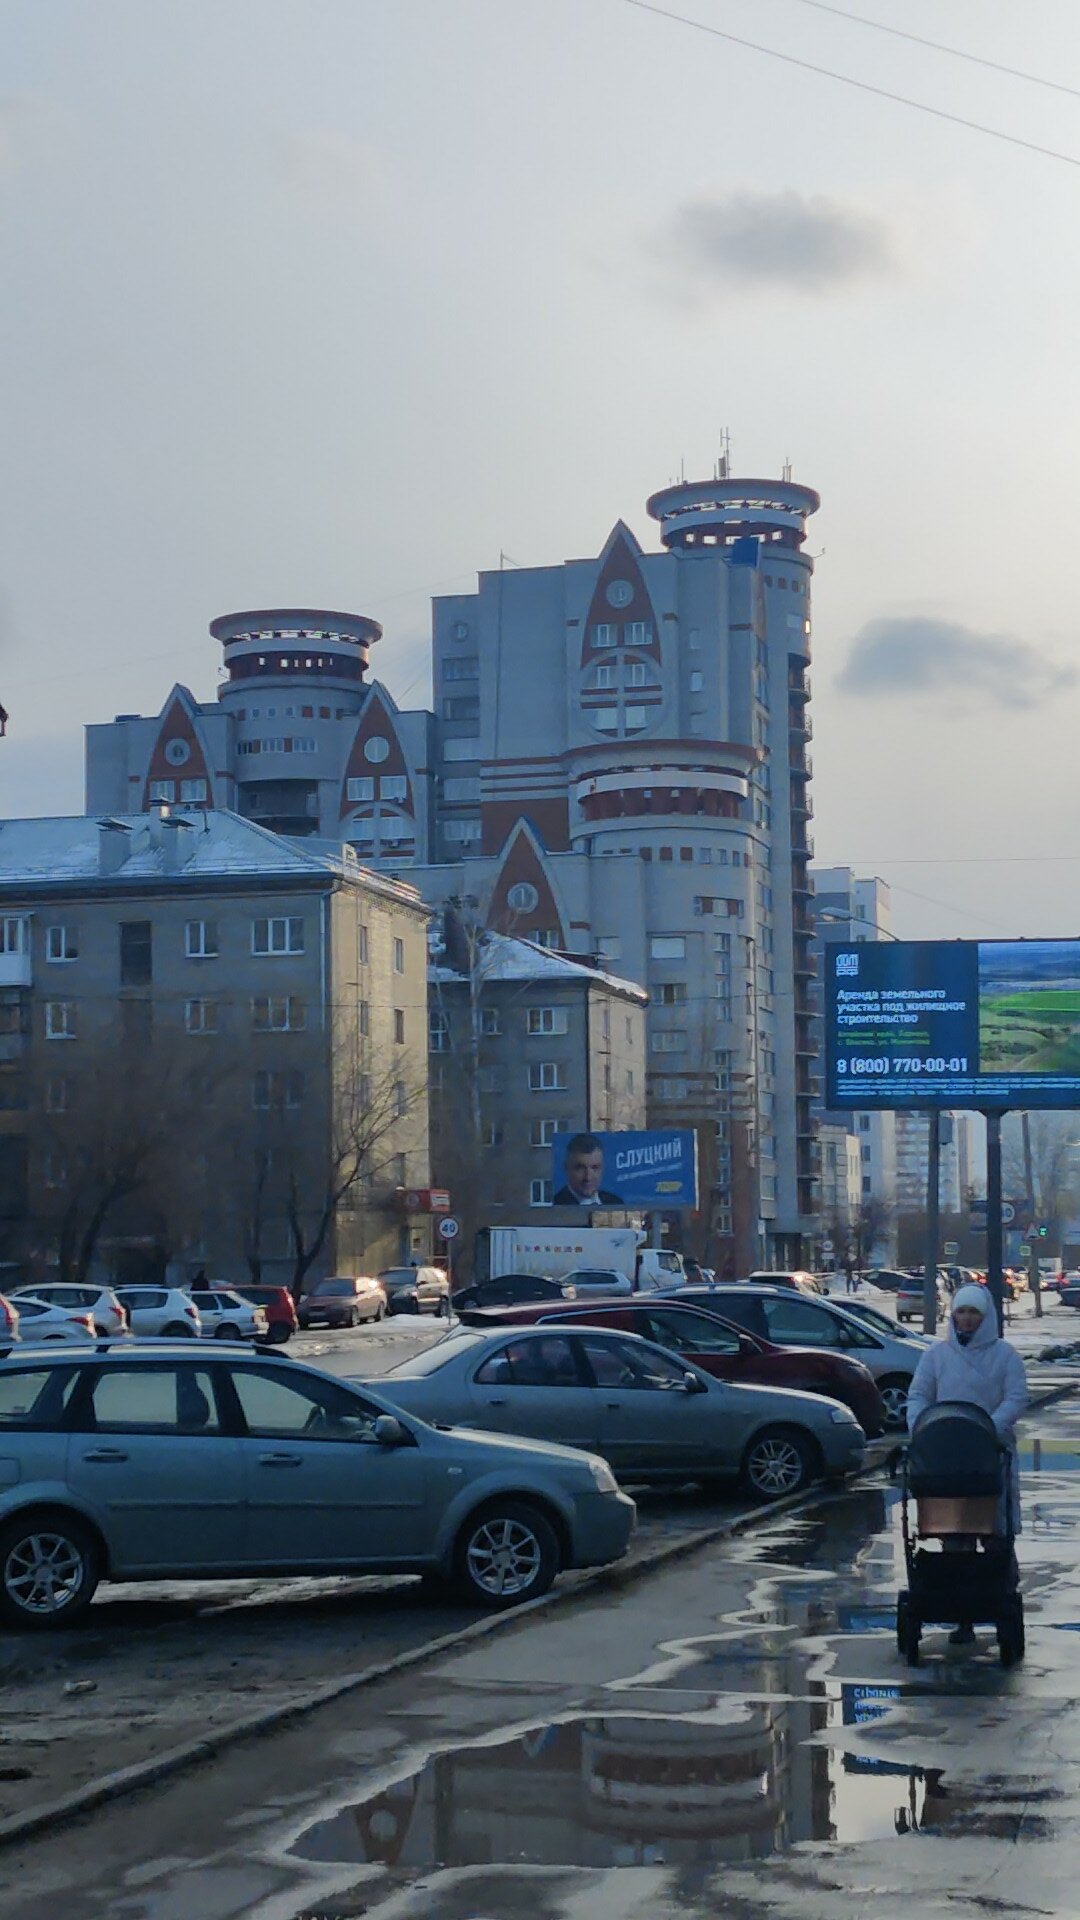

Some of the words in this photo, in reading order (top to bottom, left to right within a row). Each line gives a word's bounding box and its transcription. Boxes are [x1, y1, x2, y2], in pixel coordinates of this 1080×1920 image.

[837, 990, 879, 1001] Аренда
[881, 990, 946, 999] земельного
[837, 1003, 881, 1014] участка
[882, 1002, 904, 1012] под
[837, 1014, 919, 1025] строительство
[837, 1059, 847, 1073] 8
[850, 1057, 889, 1074] (800)
[893, 1058, 967, 1073] 770-00-01
[616, 1138, 682, 1169] СЛУЦКИЙ
[441, 1223, 456, 1233] 40
